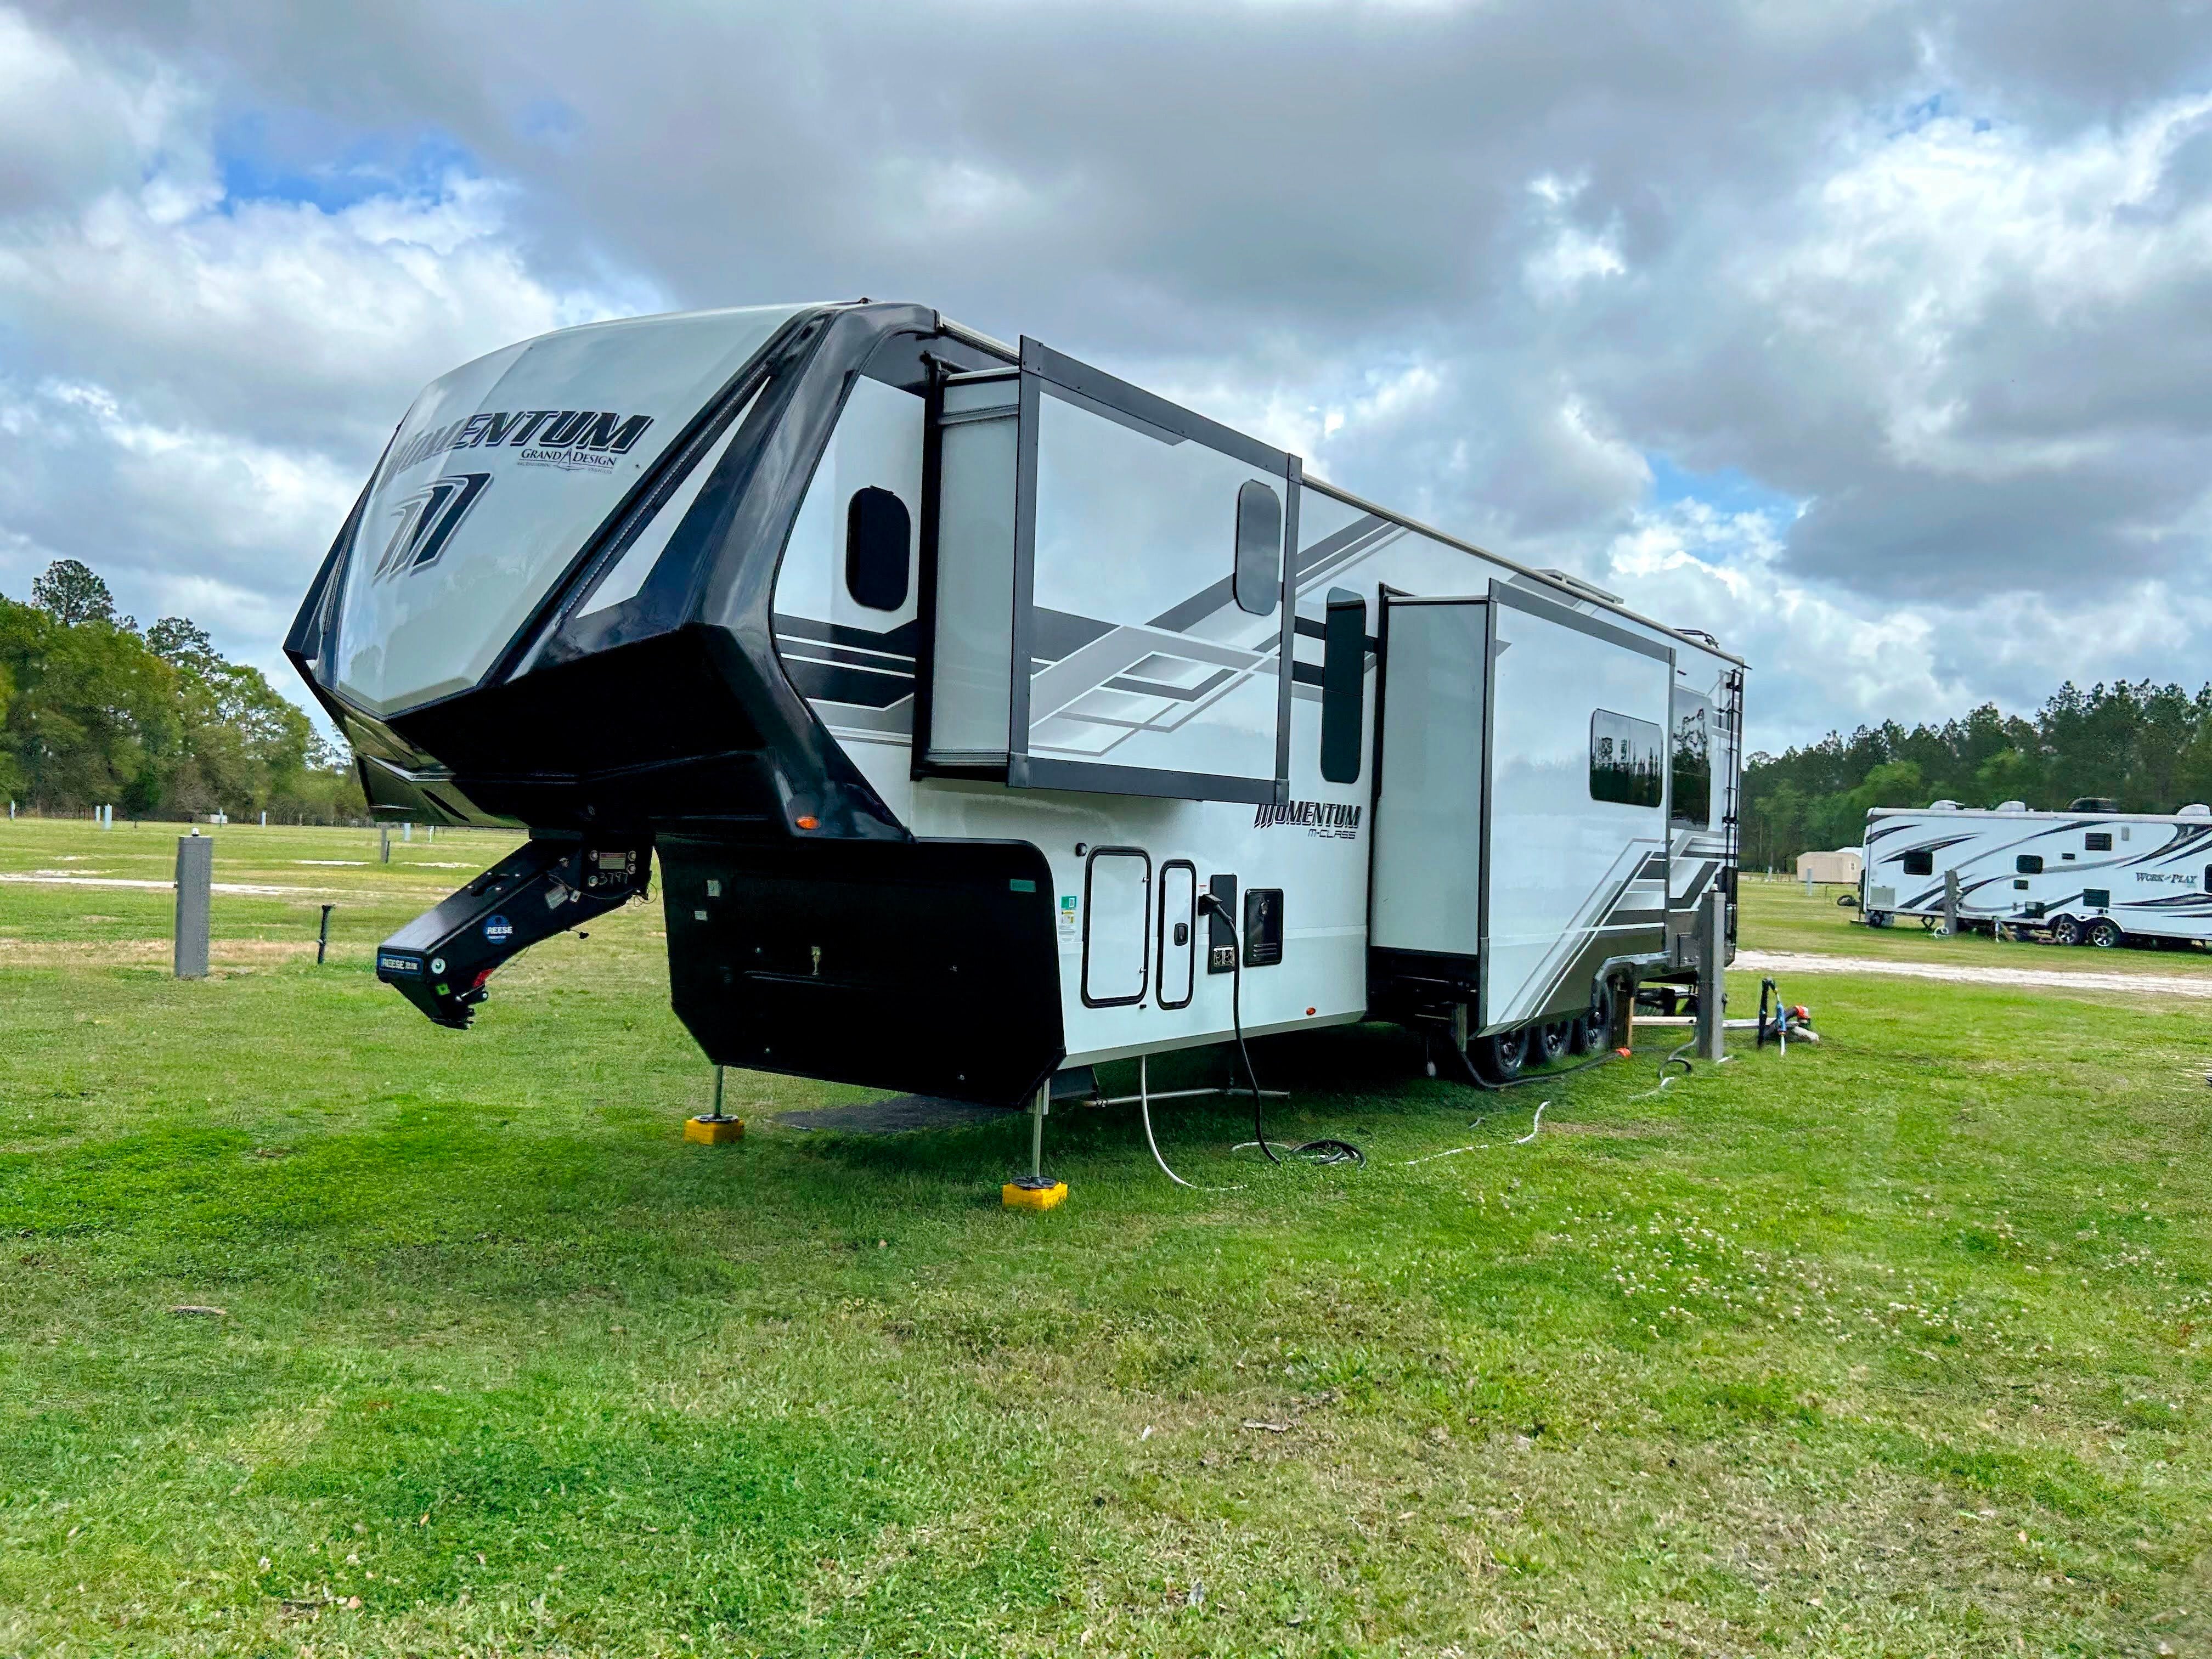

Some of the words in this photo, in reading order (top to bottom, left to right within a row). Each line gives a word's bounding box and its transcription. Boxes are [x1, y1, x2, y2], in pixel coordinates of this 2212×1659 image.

[521, 448, 562, 460] GRAND
[572, 452, 617, 466] DESIGN
[1254, 800, 1362, 829] MOMENTUM
[1308, 828, 1356, 839] M-CLASS
[487, 926, 513, 934] REESE
